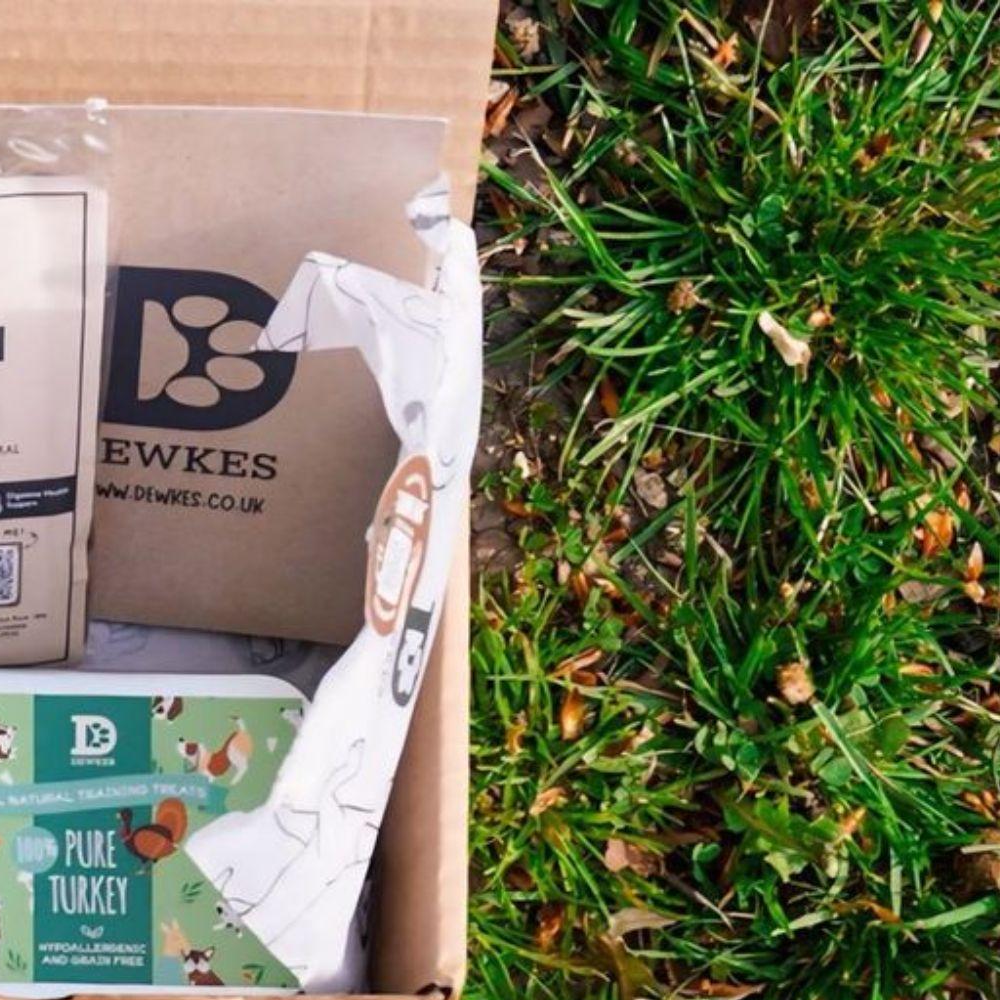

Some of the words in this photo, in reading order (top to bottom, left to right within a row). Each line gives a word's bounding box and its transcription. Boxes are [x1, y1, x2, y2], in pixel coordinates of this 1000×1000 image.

[101, 437, 278, 481] EWKES
[95, 482, 265, 515] WW.DEWKES.CO.UK
[8, 789, 74, 805] NATURAL
[77, 783, 149, 800] TRAINING
[152, 783, 206, 799] TREATS
[65, 828, 116, 869] PURE
[48, 874, 128, 916] TURKEY
[39, 943, 147, 956] HYPOALLERGENIC
[41, 956, 69, 967] AND
[113, 956, 146, 968] FREE
